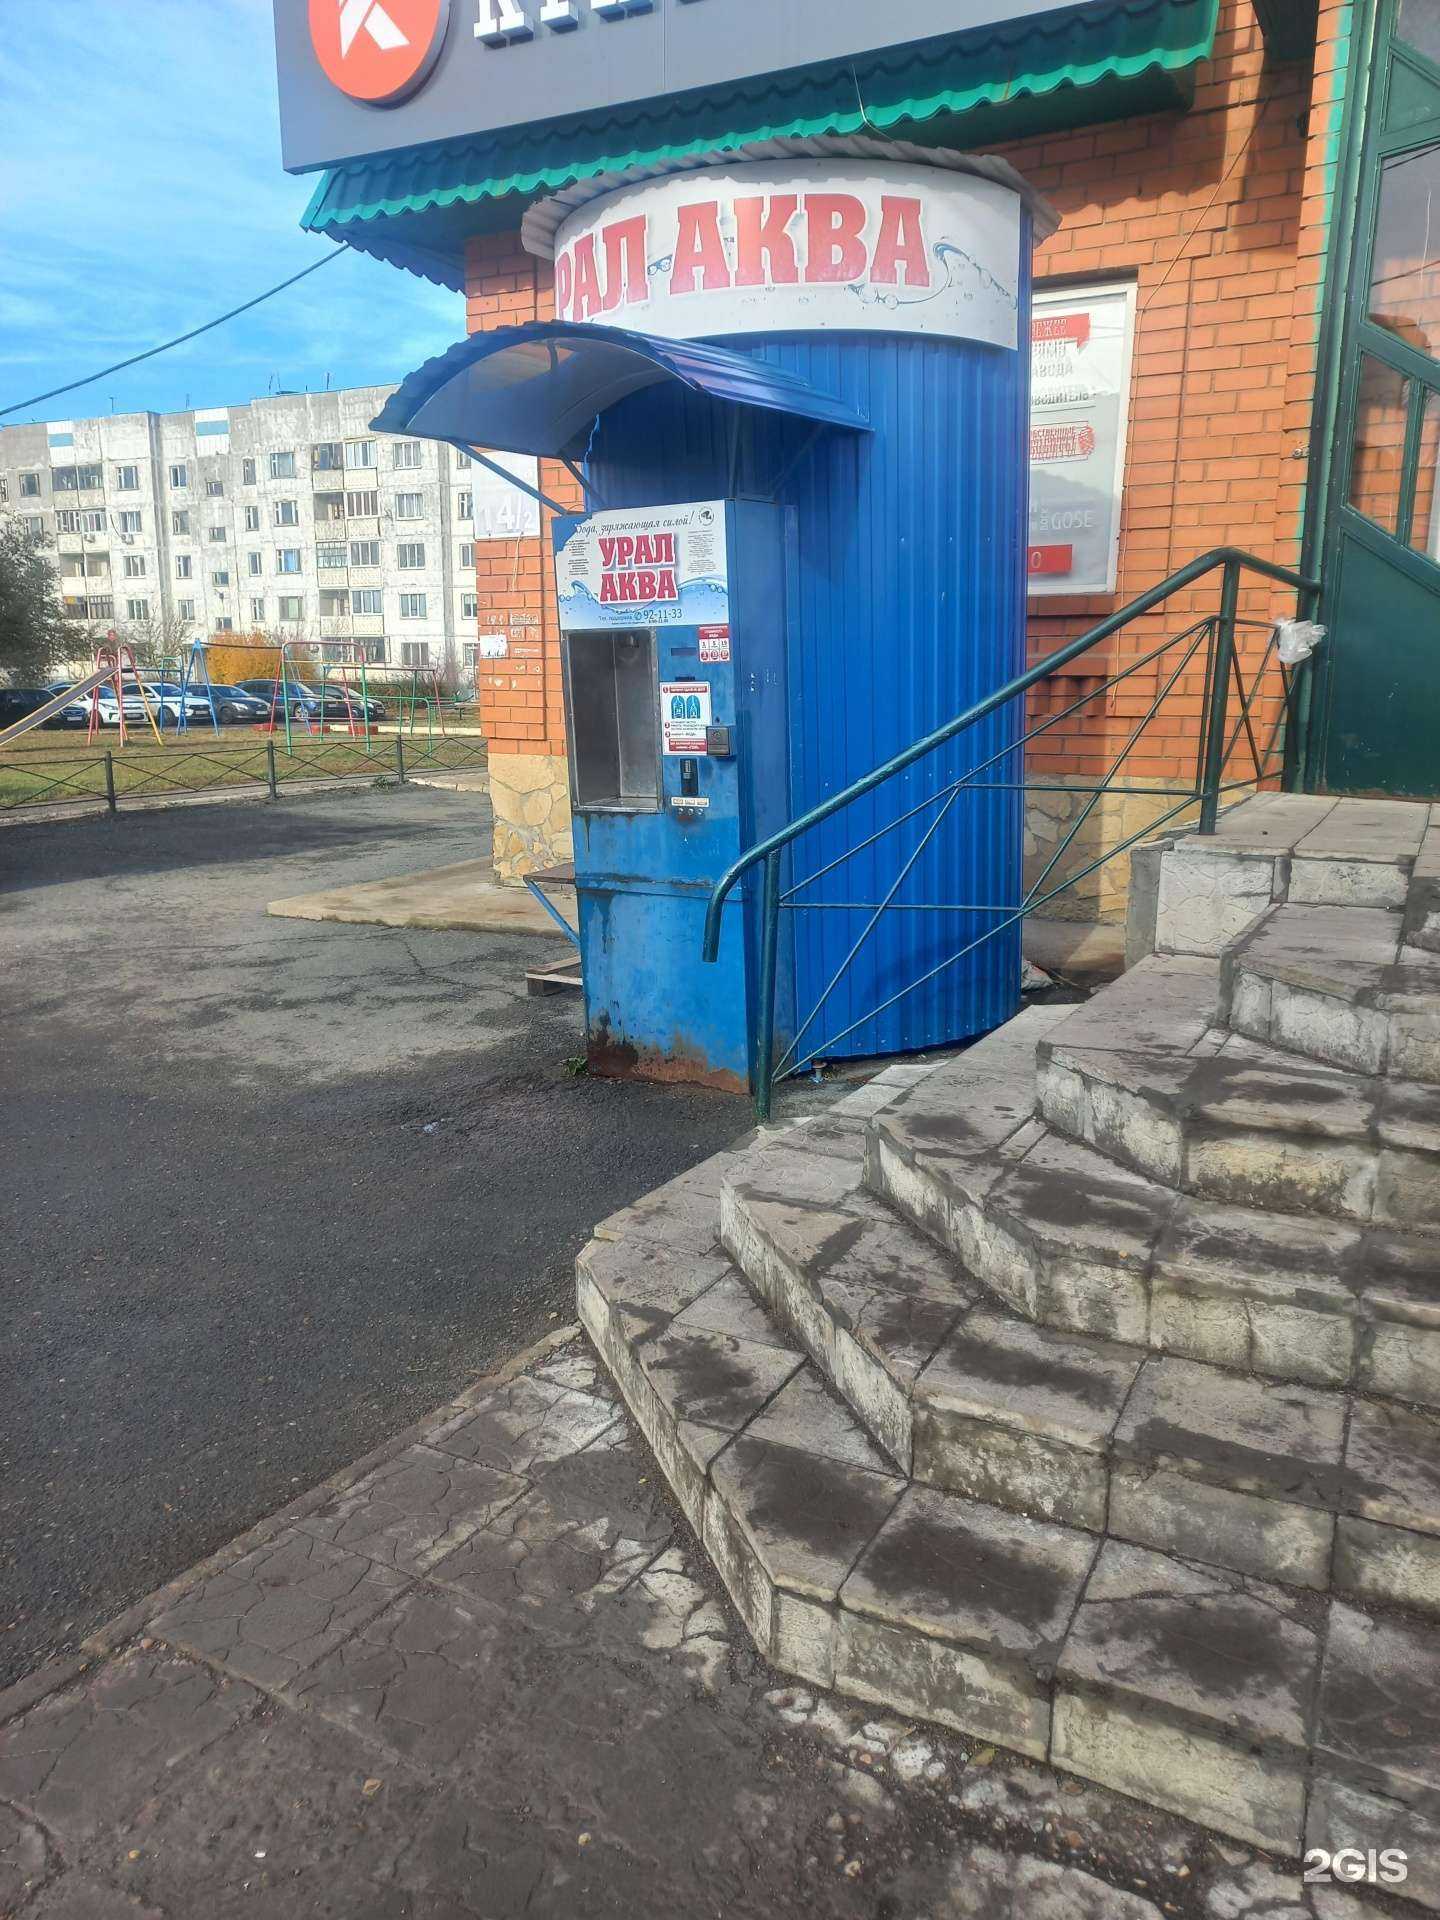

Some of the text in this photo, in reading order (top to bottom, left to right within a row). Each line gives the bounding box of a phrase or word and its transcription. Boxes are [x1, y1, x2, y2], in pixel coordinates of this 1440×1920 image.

[555, 192, 931, 322] РАЛ АКВА
[601, 520, 660, 535] заряжающая
[662, 511, 695, 527] силой!
[598, 532, 675, 566] УРАЛ
[600, 569, 677, 602] АКВА
[643, 608, 683, 620] 92-11-33
